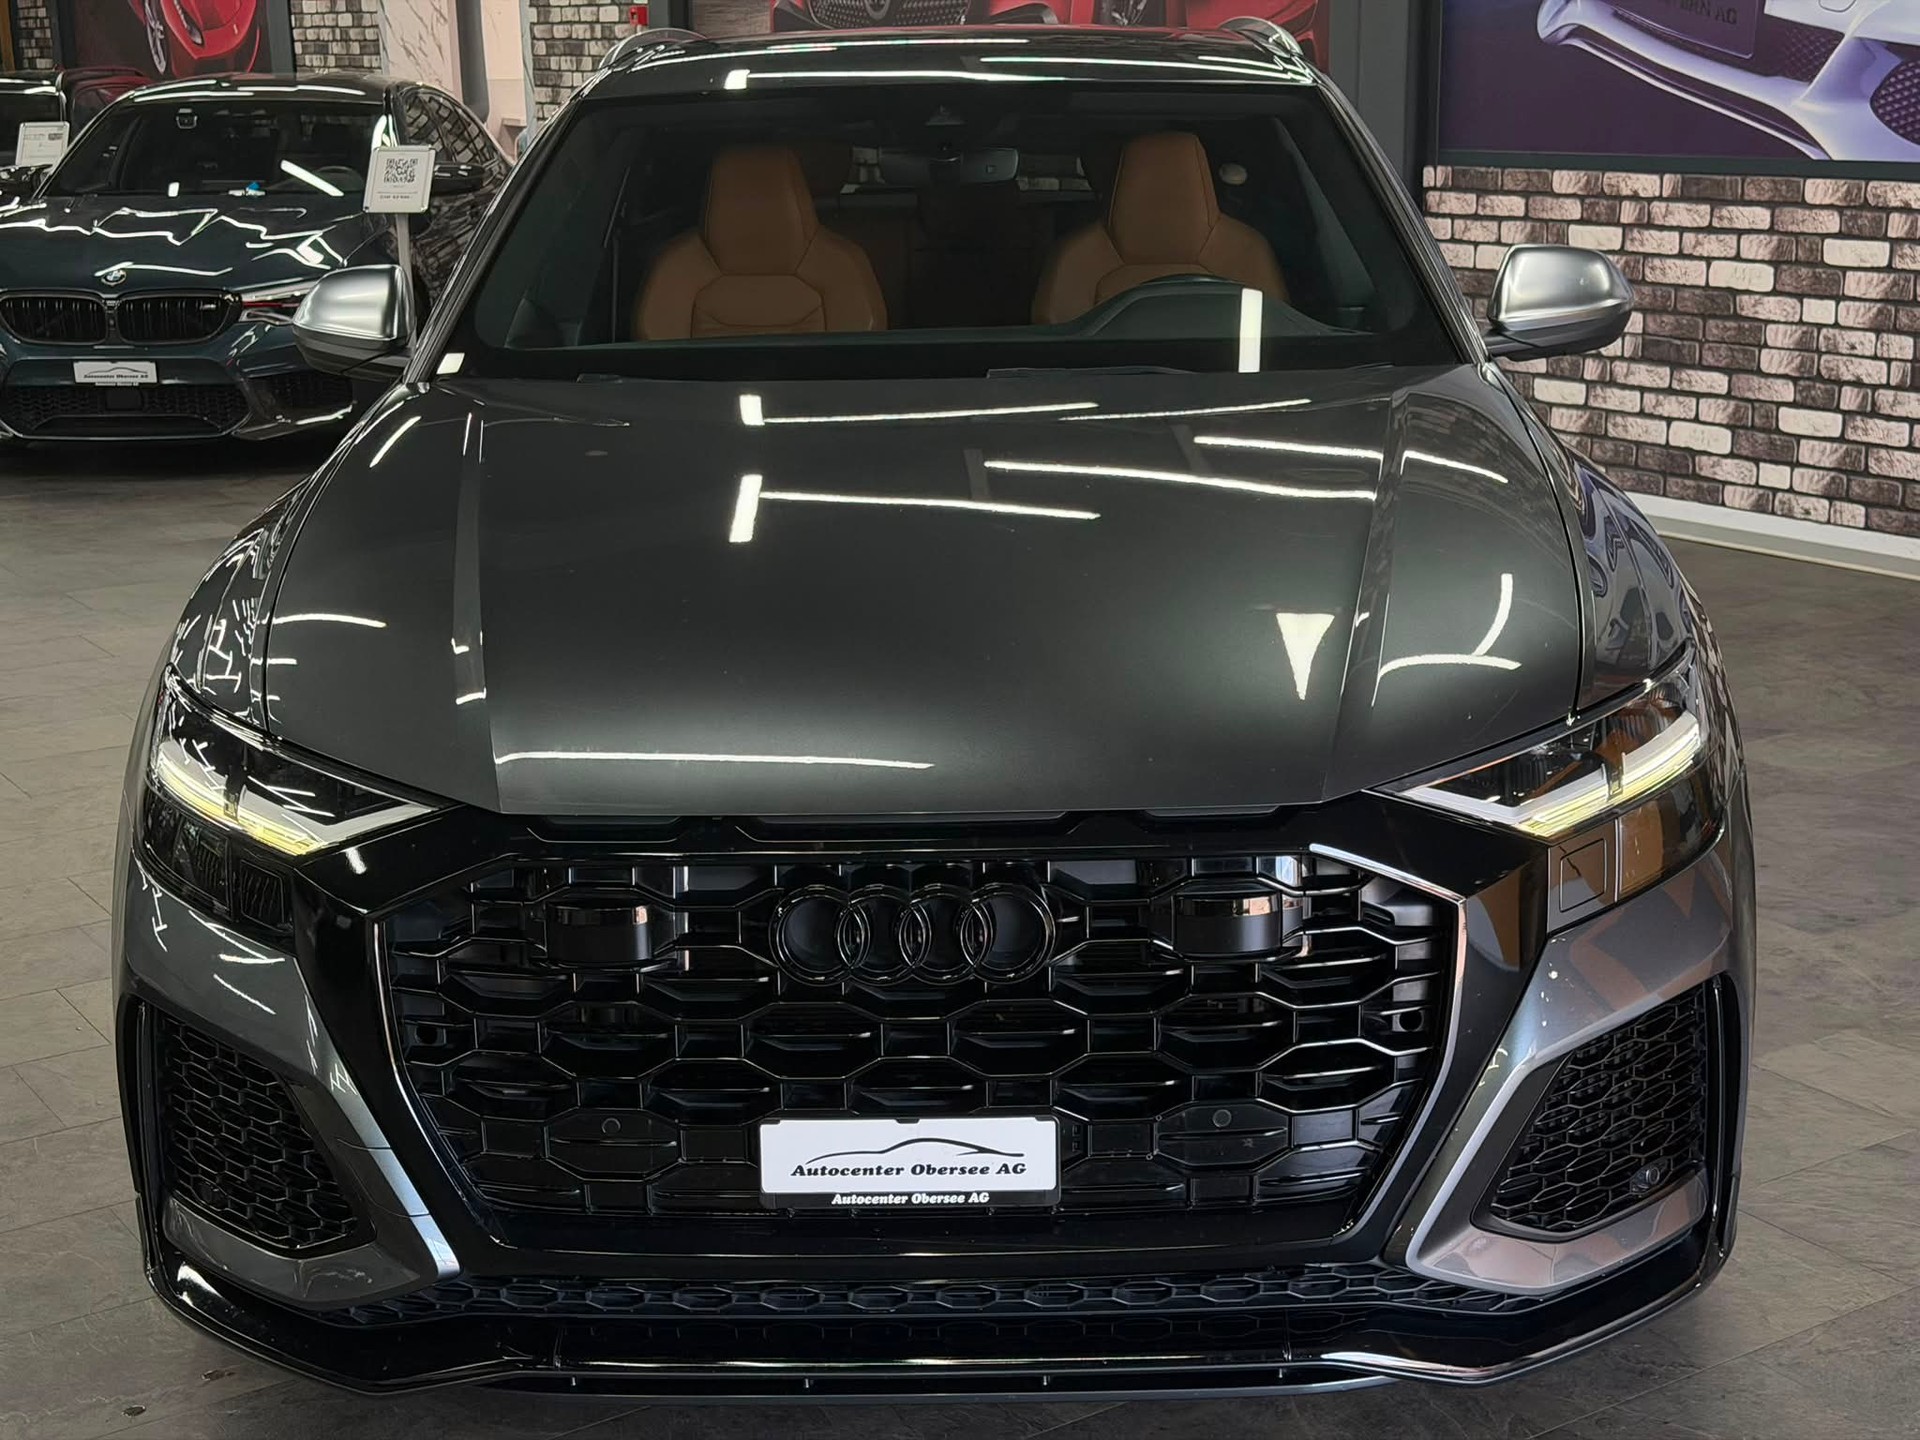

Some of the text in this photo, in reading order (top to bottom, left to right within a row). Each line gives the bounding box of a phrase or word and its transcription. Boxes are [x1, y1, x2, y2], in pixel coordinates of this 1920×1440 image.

[790, 1162, 1027, 1177] Autocenter Obersee AG
[831, 1191, 990, 1205] Autocenter Obersee AG
